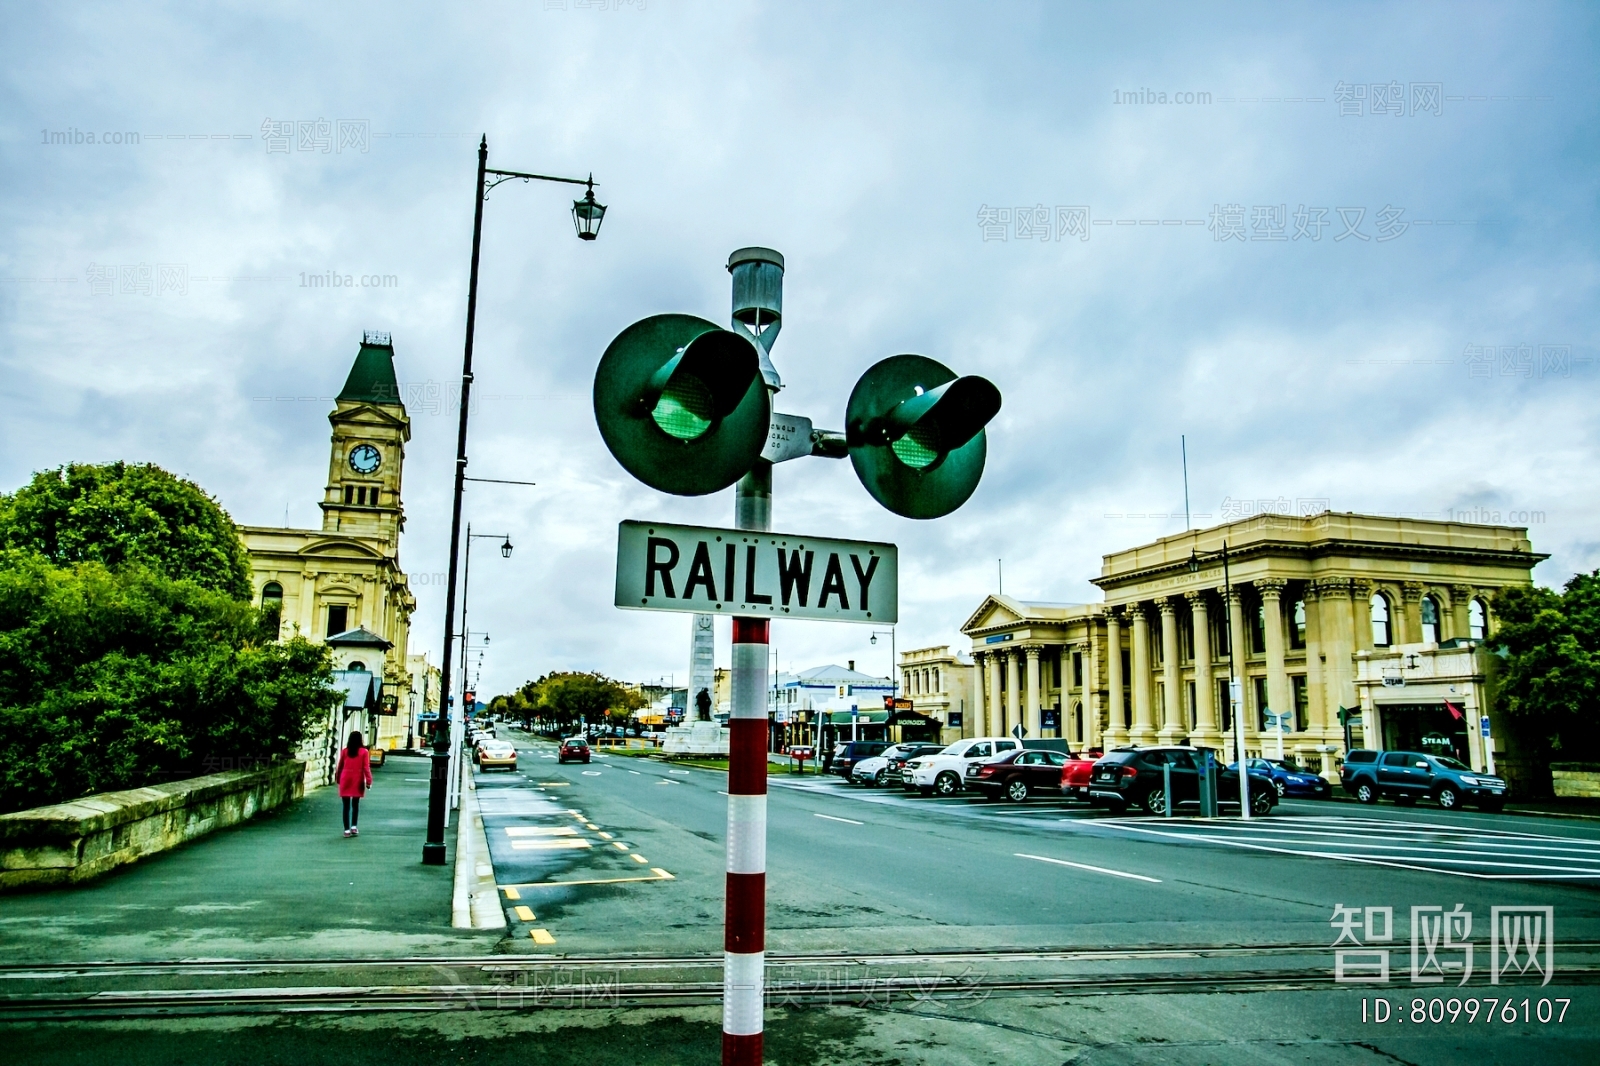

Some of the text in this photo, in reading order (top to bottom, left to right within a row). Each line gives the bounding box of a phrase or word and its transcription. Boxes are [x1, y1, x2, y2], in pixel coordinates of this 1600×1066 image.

[644, 536, 881, 611] RAILWAY
[1161, 579, 1175, 587] NEW
[1177, 574, 1197, 584] SOUTH
[1198, 569, 1222, 580] WALES
[1421, 737, 1451, 746] STEAM
